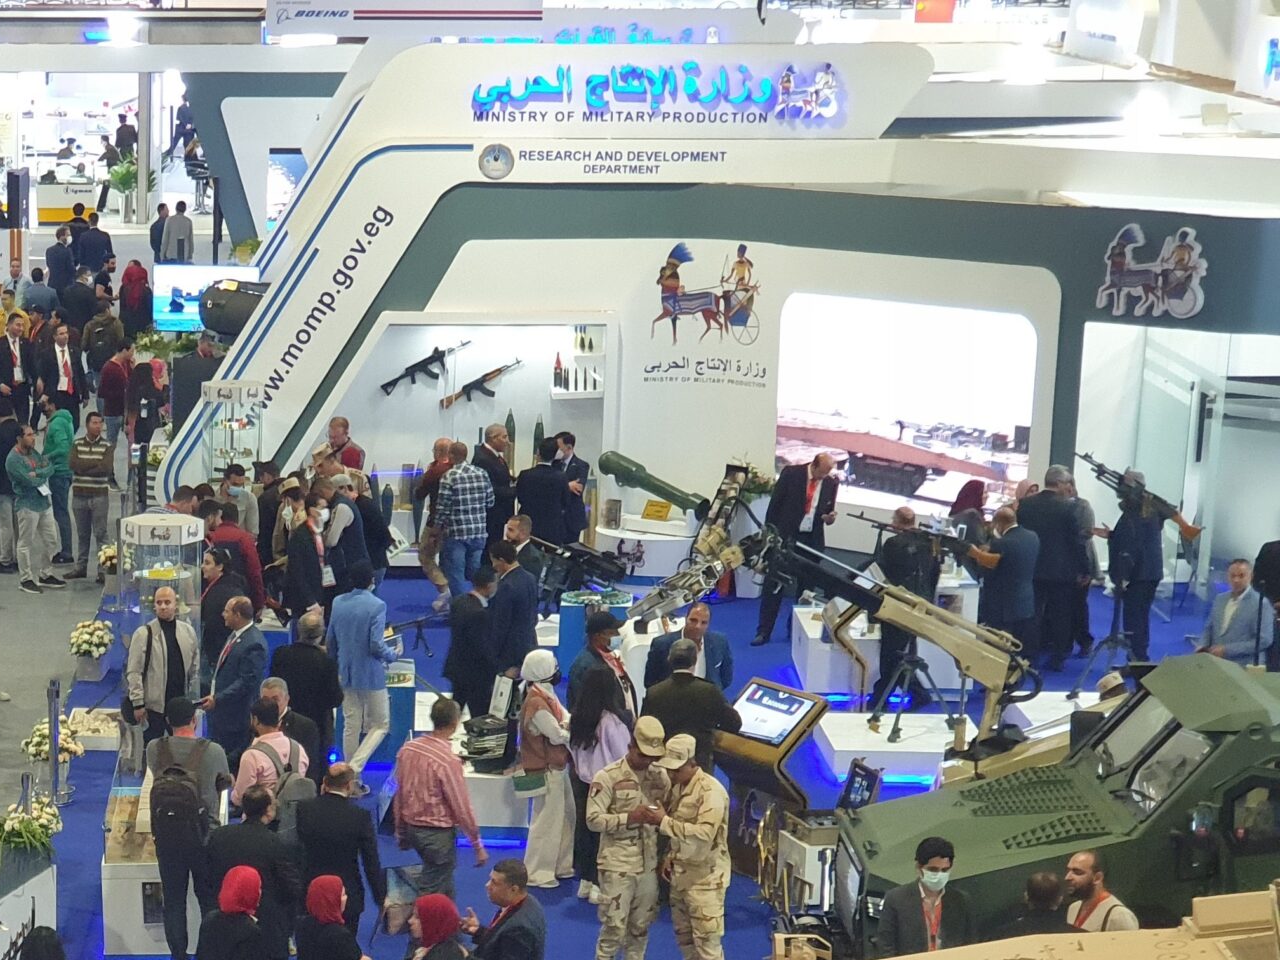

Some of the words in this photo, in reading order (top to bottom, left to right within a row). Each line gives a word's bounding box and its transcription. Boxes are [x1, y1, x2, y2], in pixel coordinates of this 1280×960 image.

[294, 10, 349, 18] BOEING
[472, 110, 548, 123] MINISTRY
[554, 110, 575, 123] OF
[581, 111, 656, 123] MILITARY
[662, 111, 769, 124] PRODUCTION
[518, 150, 593, 162] RESEARCH
[594, 151, 623, 162] AND
[626, 151, 727, 163] DEVELOPMENT
[583, 164, 661, 175] DEPARTMENT
[694, 357, 732, 376] الإنتاج
[736, 359, 767, 379] وزارة
[727, 378, 767, 388] PRODUCTION
